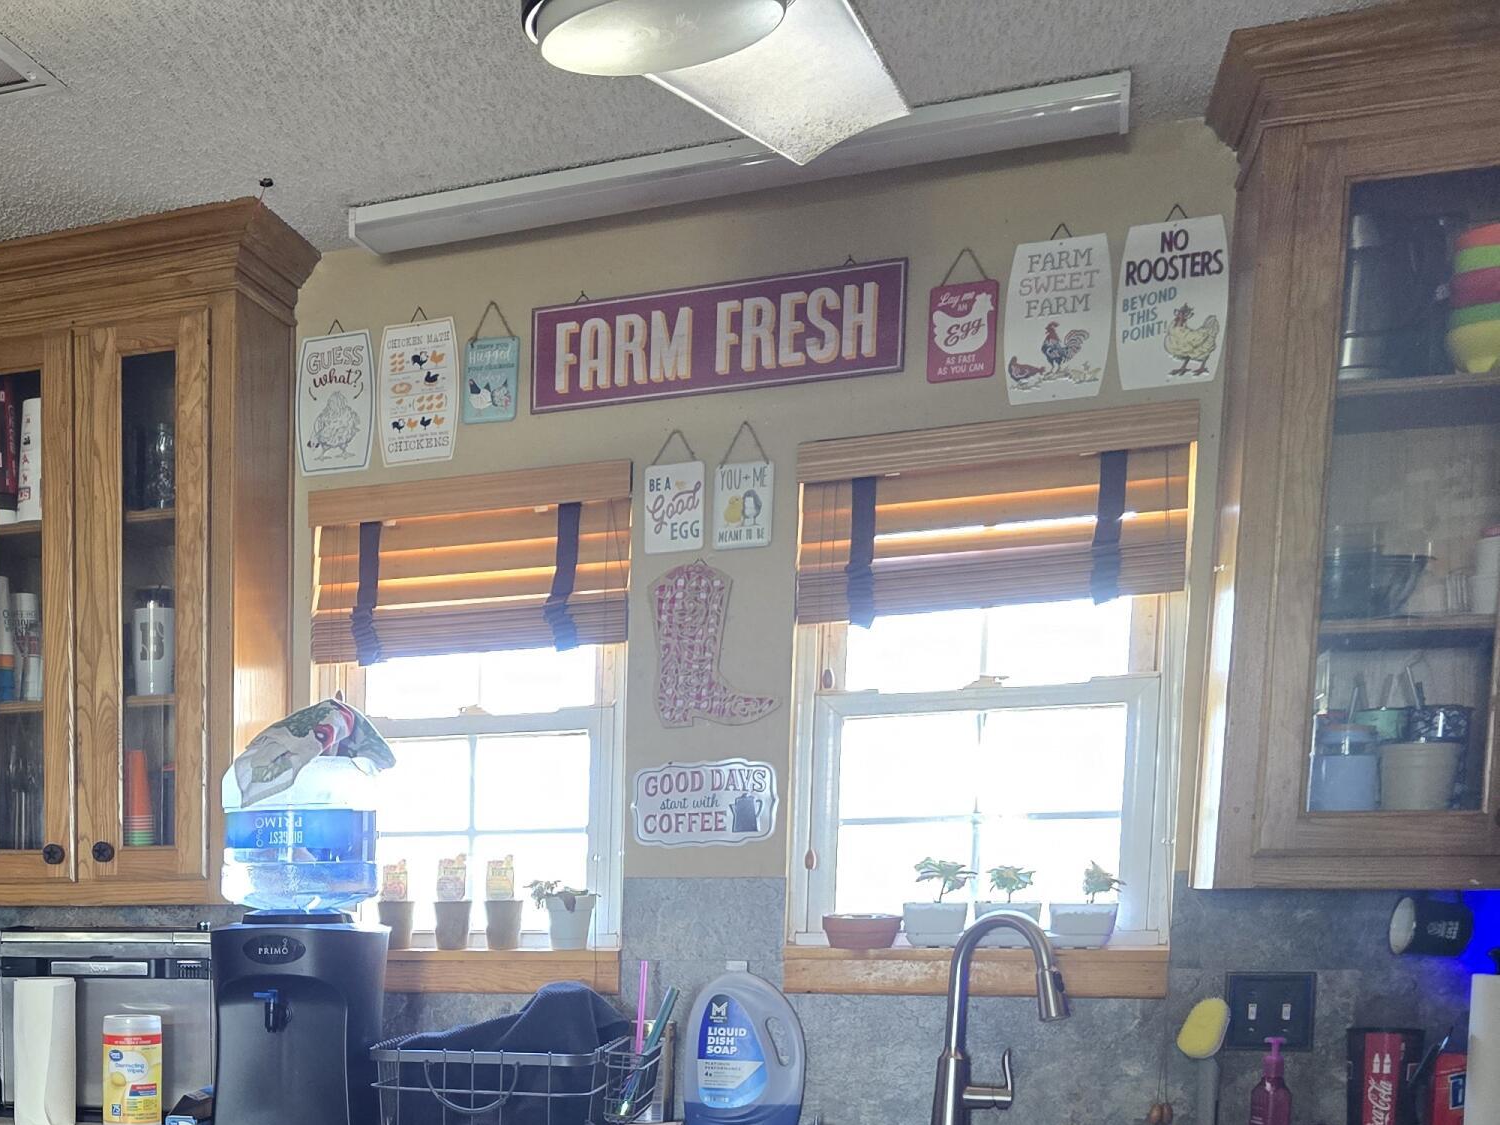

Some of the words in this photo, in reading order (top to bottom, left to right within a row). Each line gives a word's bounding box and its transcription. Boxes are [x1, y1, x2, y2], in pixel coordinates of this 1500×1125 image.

[1160, 229, 1189, 254] NO
[1027, 247, 1093, 274] FARM
[1125, 248, 1224, 287] ROOSTERS
[1018, 269, 1100, 297] SWEET
[937, 292, 960, 309] Lay
[957, 303, 969, 312] AN
[1024, 293, 1091, 319] FARM
[1122, 286, 1177, 313] BEYOND
[1128, 306, 1158, 327] THIS
[386, 335, 423, 350] CHICKEN
[426, 330, 451, 345] MATH
[554, 306, 693, 394] FARM
[715, 281, 879, 375] FRESH
[943, 317, 986, 347] Egg
[1122, 319, 1168, 344] POINT!
[306, 345, 365, 375] GUESS
[937, 366, 948, 376] AS
[950, 363, 967, 375] YOU
[968, 361, 985, 373] CAN
[945, 356, 957, 366] AS
[958, 353, 977, 363] FAST
[313, 368, 363, 388] what?
[387, 435, 450, 454] CHICKENS
[648, 477, 661, 493] BE
[664, 476, 672, 491] A
[719, 466, 742, 491] YOU
[752, 465, 768, 489] ME
[646, 480, 702, 535] Good
[670, 519, 701, 541] EGG
[718, 528, 742, 543] MEANT
[756, 527, 766, 540] BE
[644, 770, 705, 797] GOOD
[710, 768, 767, 793] DAYS
[660, 798, 689, 811] start
[692, 792, 720, 809] with
[643, 810, 727, 834] COFFEE
[268, 830, 303, 844] BIGEST
[258, 946, 289, 955] PRIMO
[707, 1026, 747, 1037] LIQUID
[707, 1036, 735, 1046] DISH
[706, 1045, 738, 1055] SOAP
